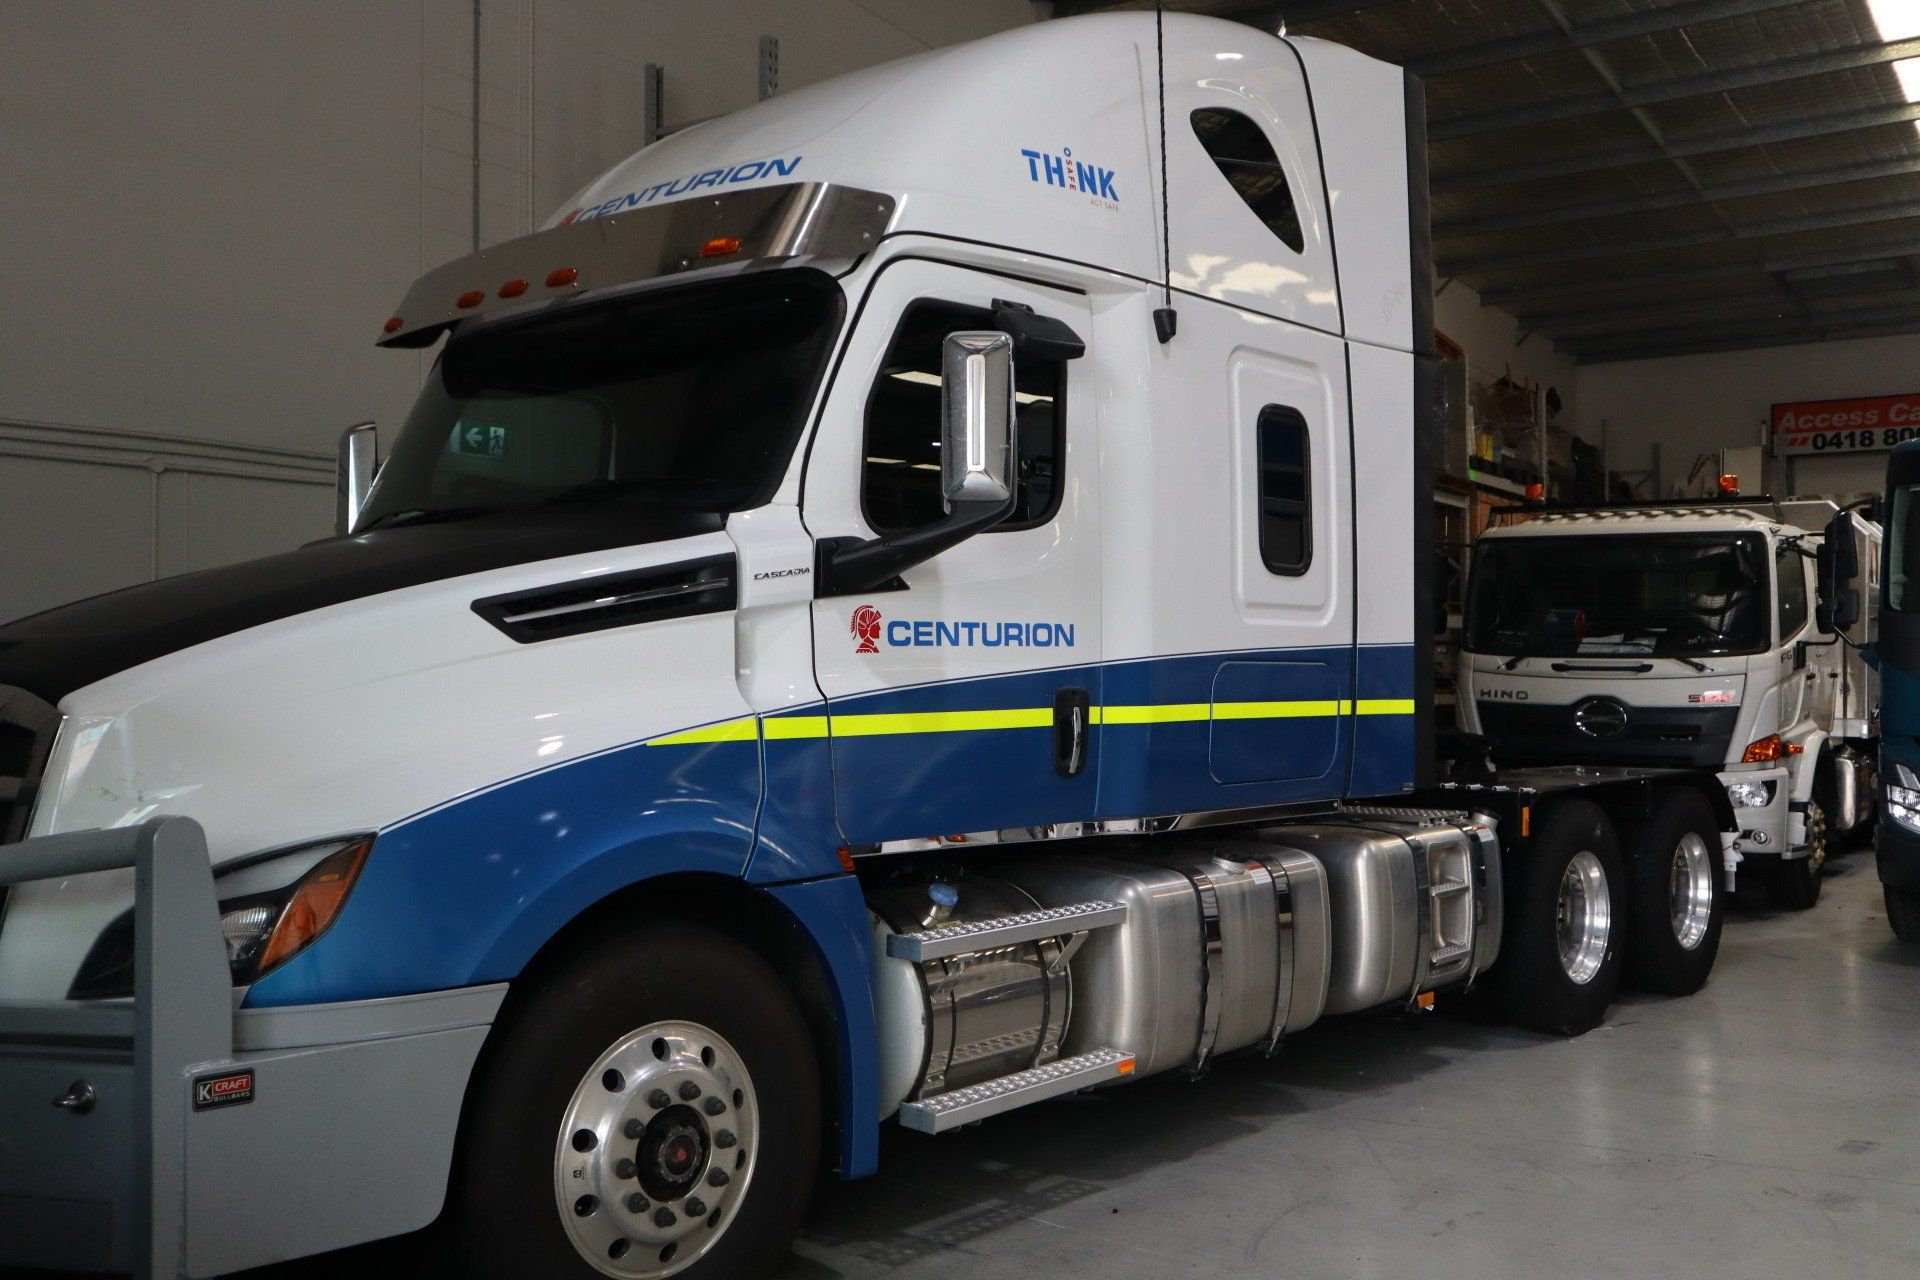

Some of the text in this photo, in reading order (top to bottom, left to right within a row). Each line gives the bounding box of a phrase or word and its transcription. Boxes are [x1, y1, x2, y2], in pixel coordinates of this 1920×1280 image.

[577, 156, 802, 223] CENTURION
[1779, 409, 1879, 431] Access
[1811, 429, 1875, 451] 0418
[754, 566, 811, 580] CASCADIA
[887, 620, 1075, 648] CENTURION
[1480, 689, 1529, 700] HINO
[199, 1079, 247, 1101] K CRAFT
[214, 1092, 250, 1102] BULLBARS
